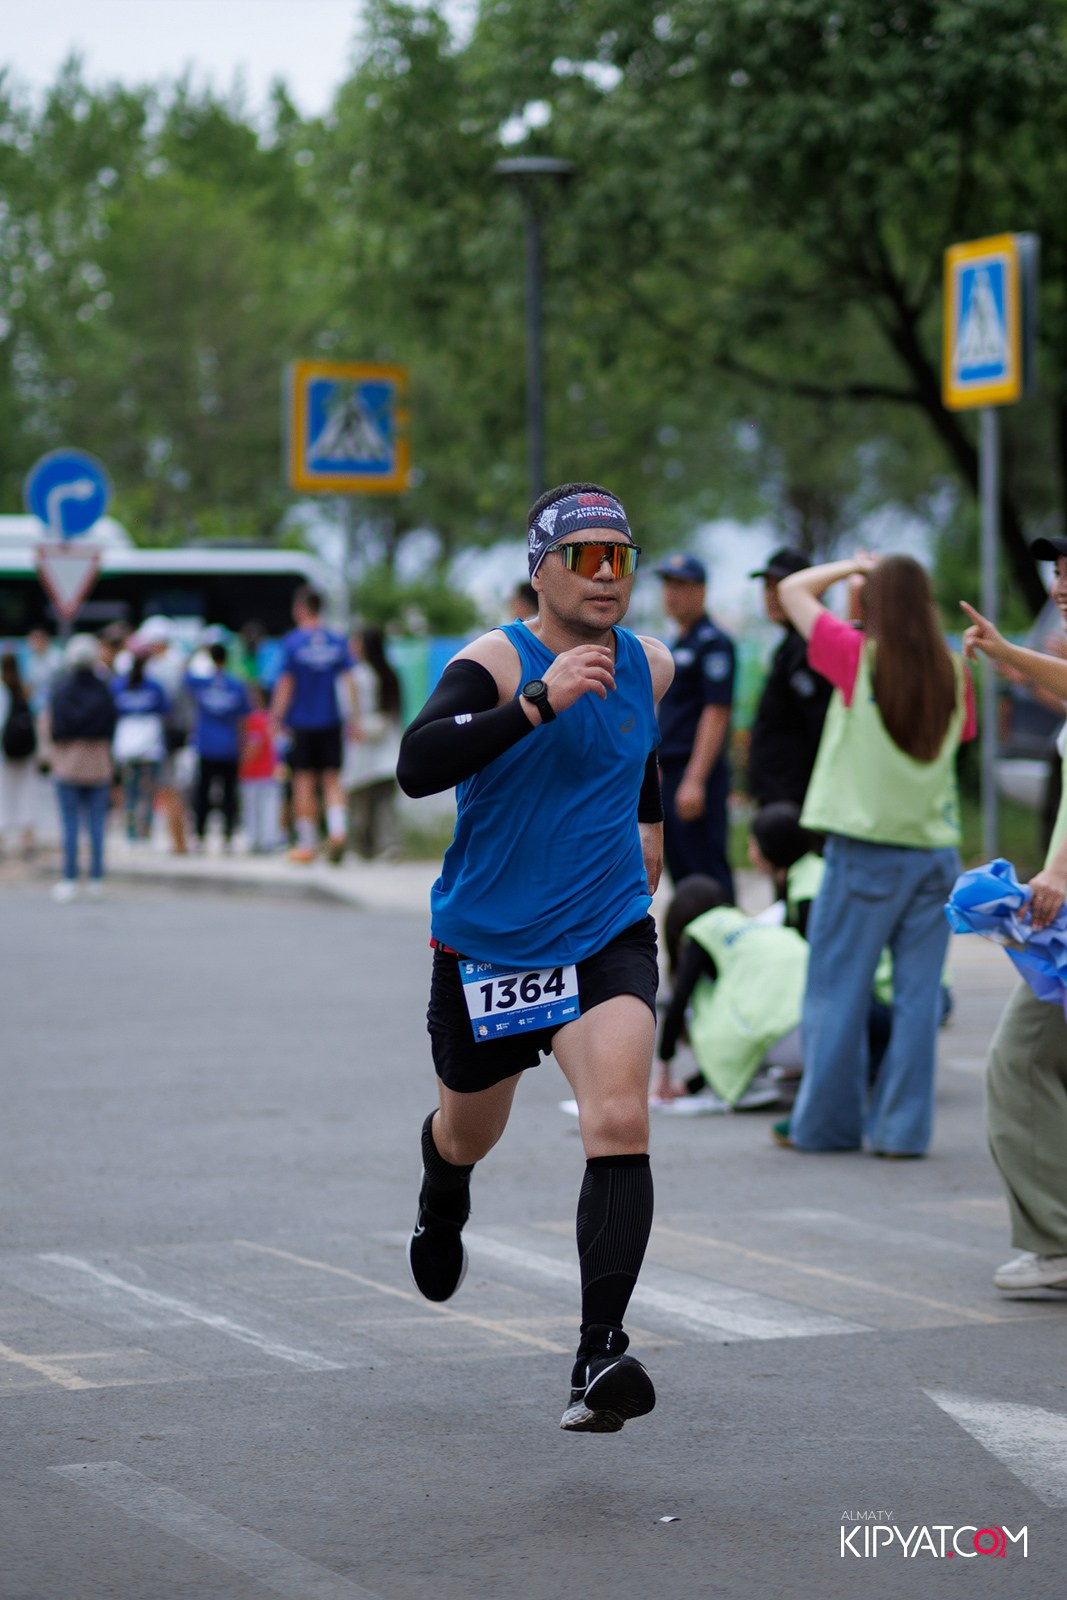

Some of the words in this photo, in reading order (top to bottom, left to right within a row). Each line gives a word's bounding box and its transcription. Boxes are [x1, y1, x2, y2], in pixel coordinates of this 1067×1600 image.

[576, 510, 618, 519] АТЛЕТИКА
[465, 963, 474, 974] 5
[476, 963, 492, 972] KM
[480, 967, 566, 1012] 1364
